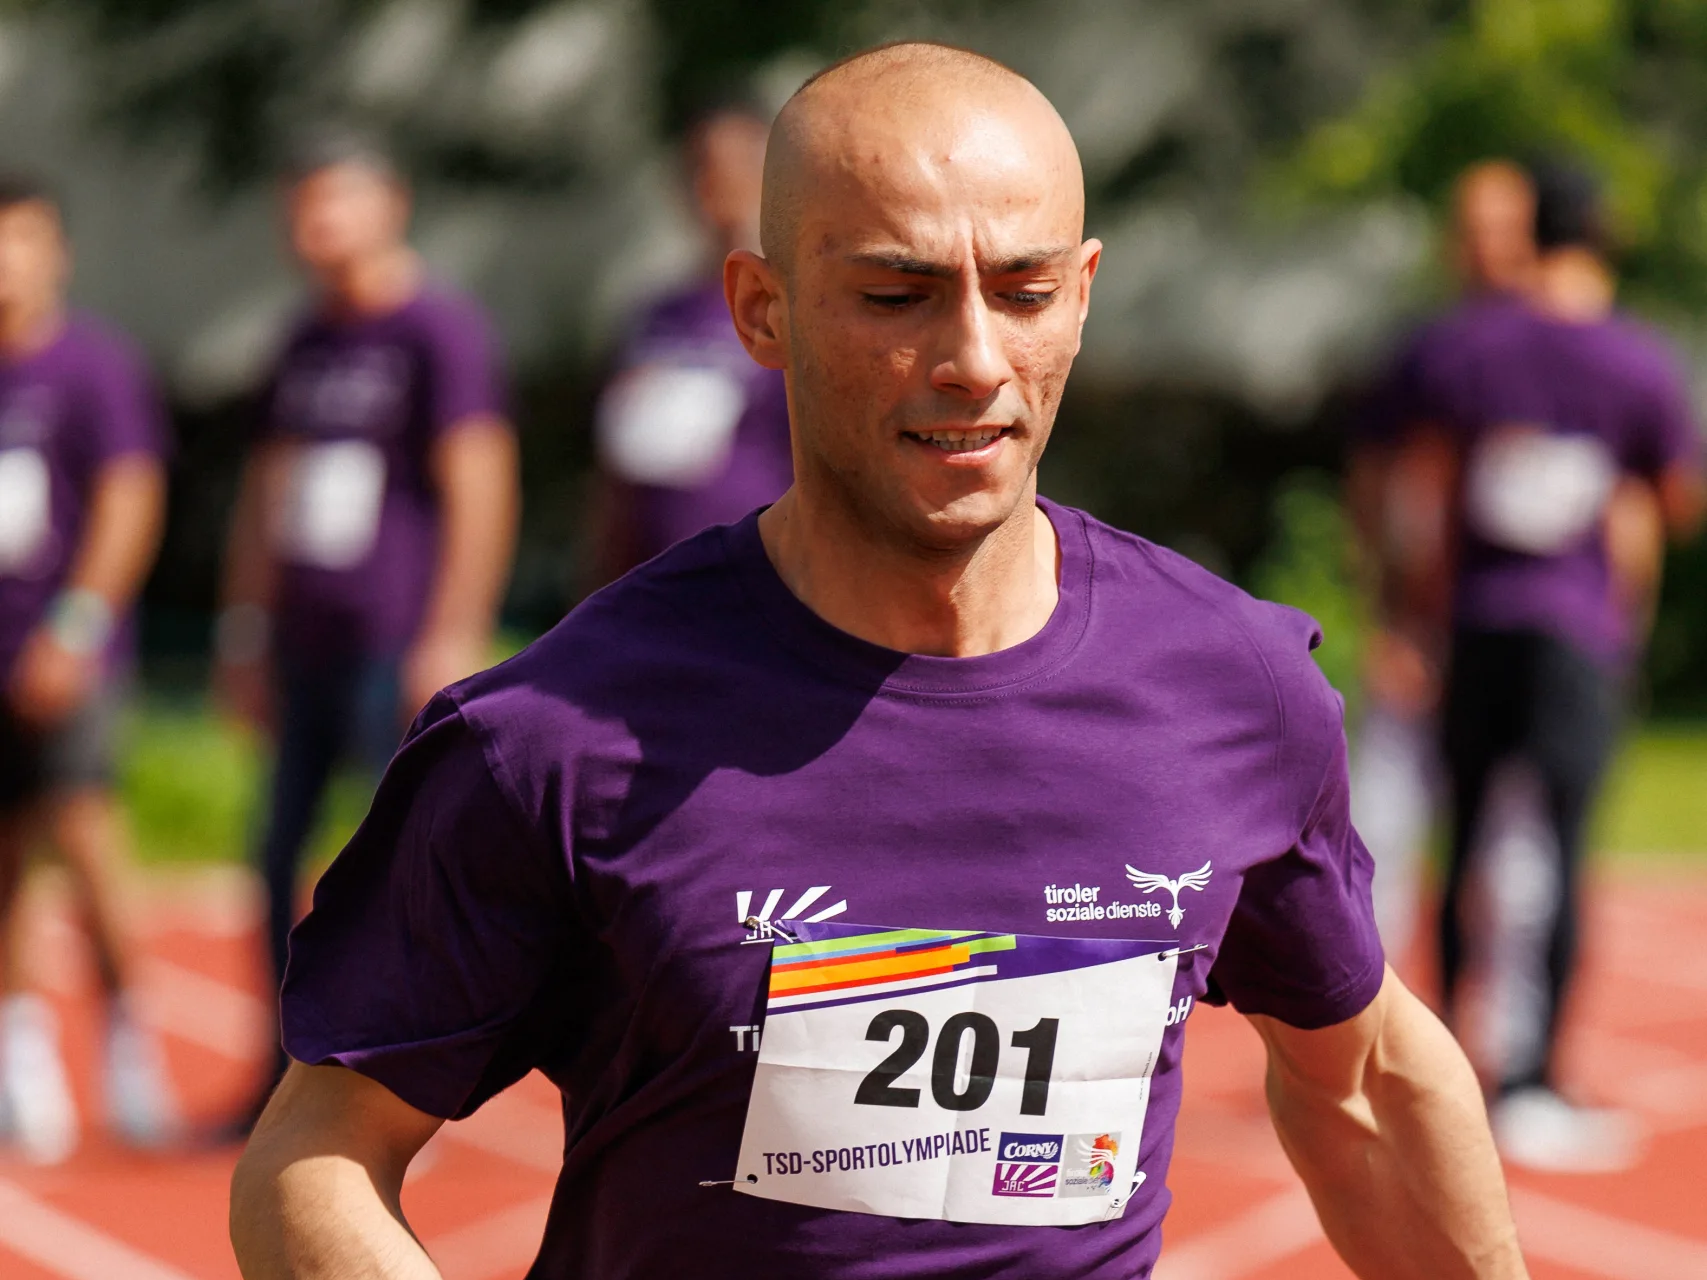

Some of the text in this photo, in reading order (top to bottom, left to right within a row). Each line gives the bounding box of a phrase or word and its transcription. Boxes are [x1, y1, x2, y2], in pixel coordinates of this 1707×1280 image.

[1044, 883, 1101, 904] tiroler
[1046, 900, 1161, 923] soziale dienste
[854, 1009, 1060, 1117] 201
[763, 1128, 991, 1175] TSD-SPORTOLYMPIADE
[1001, 1180, 1025, 1192] JAC
